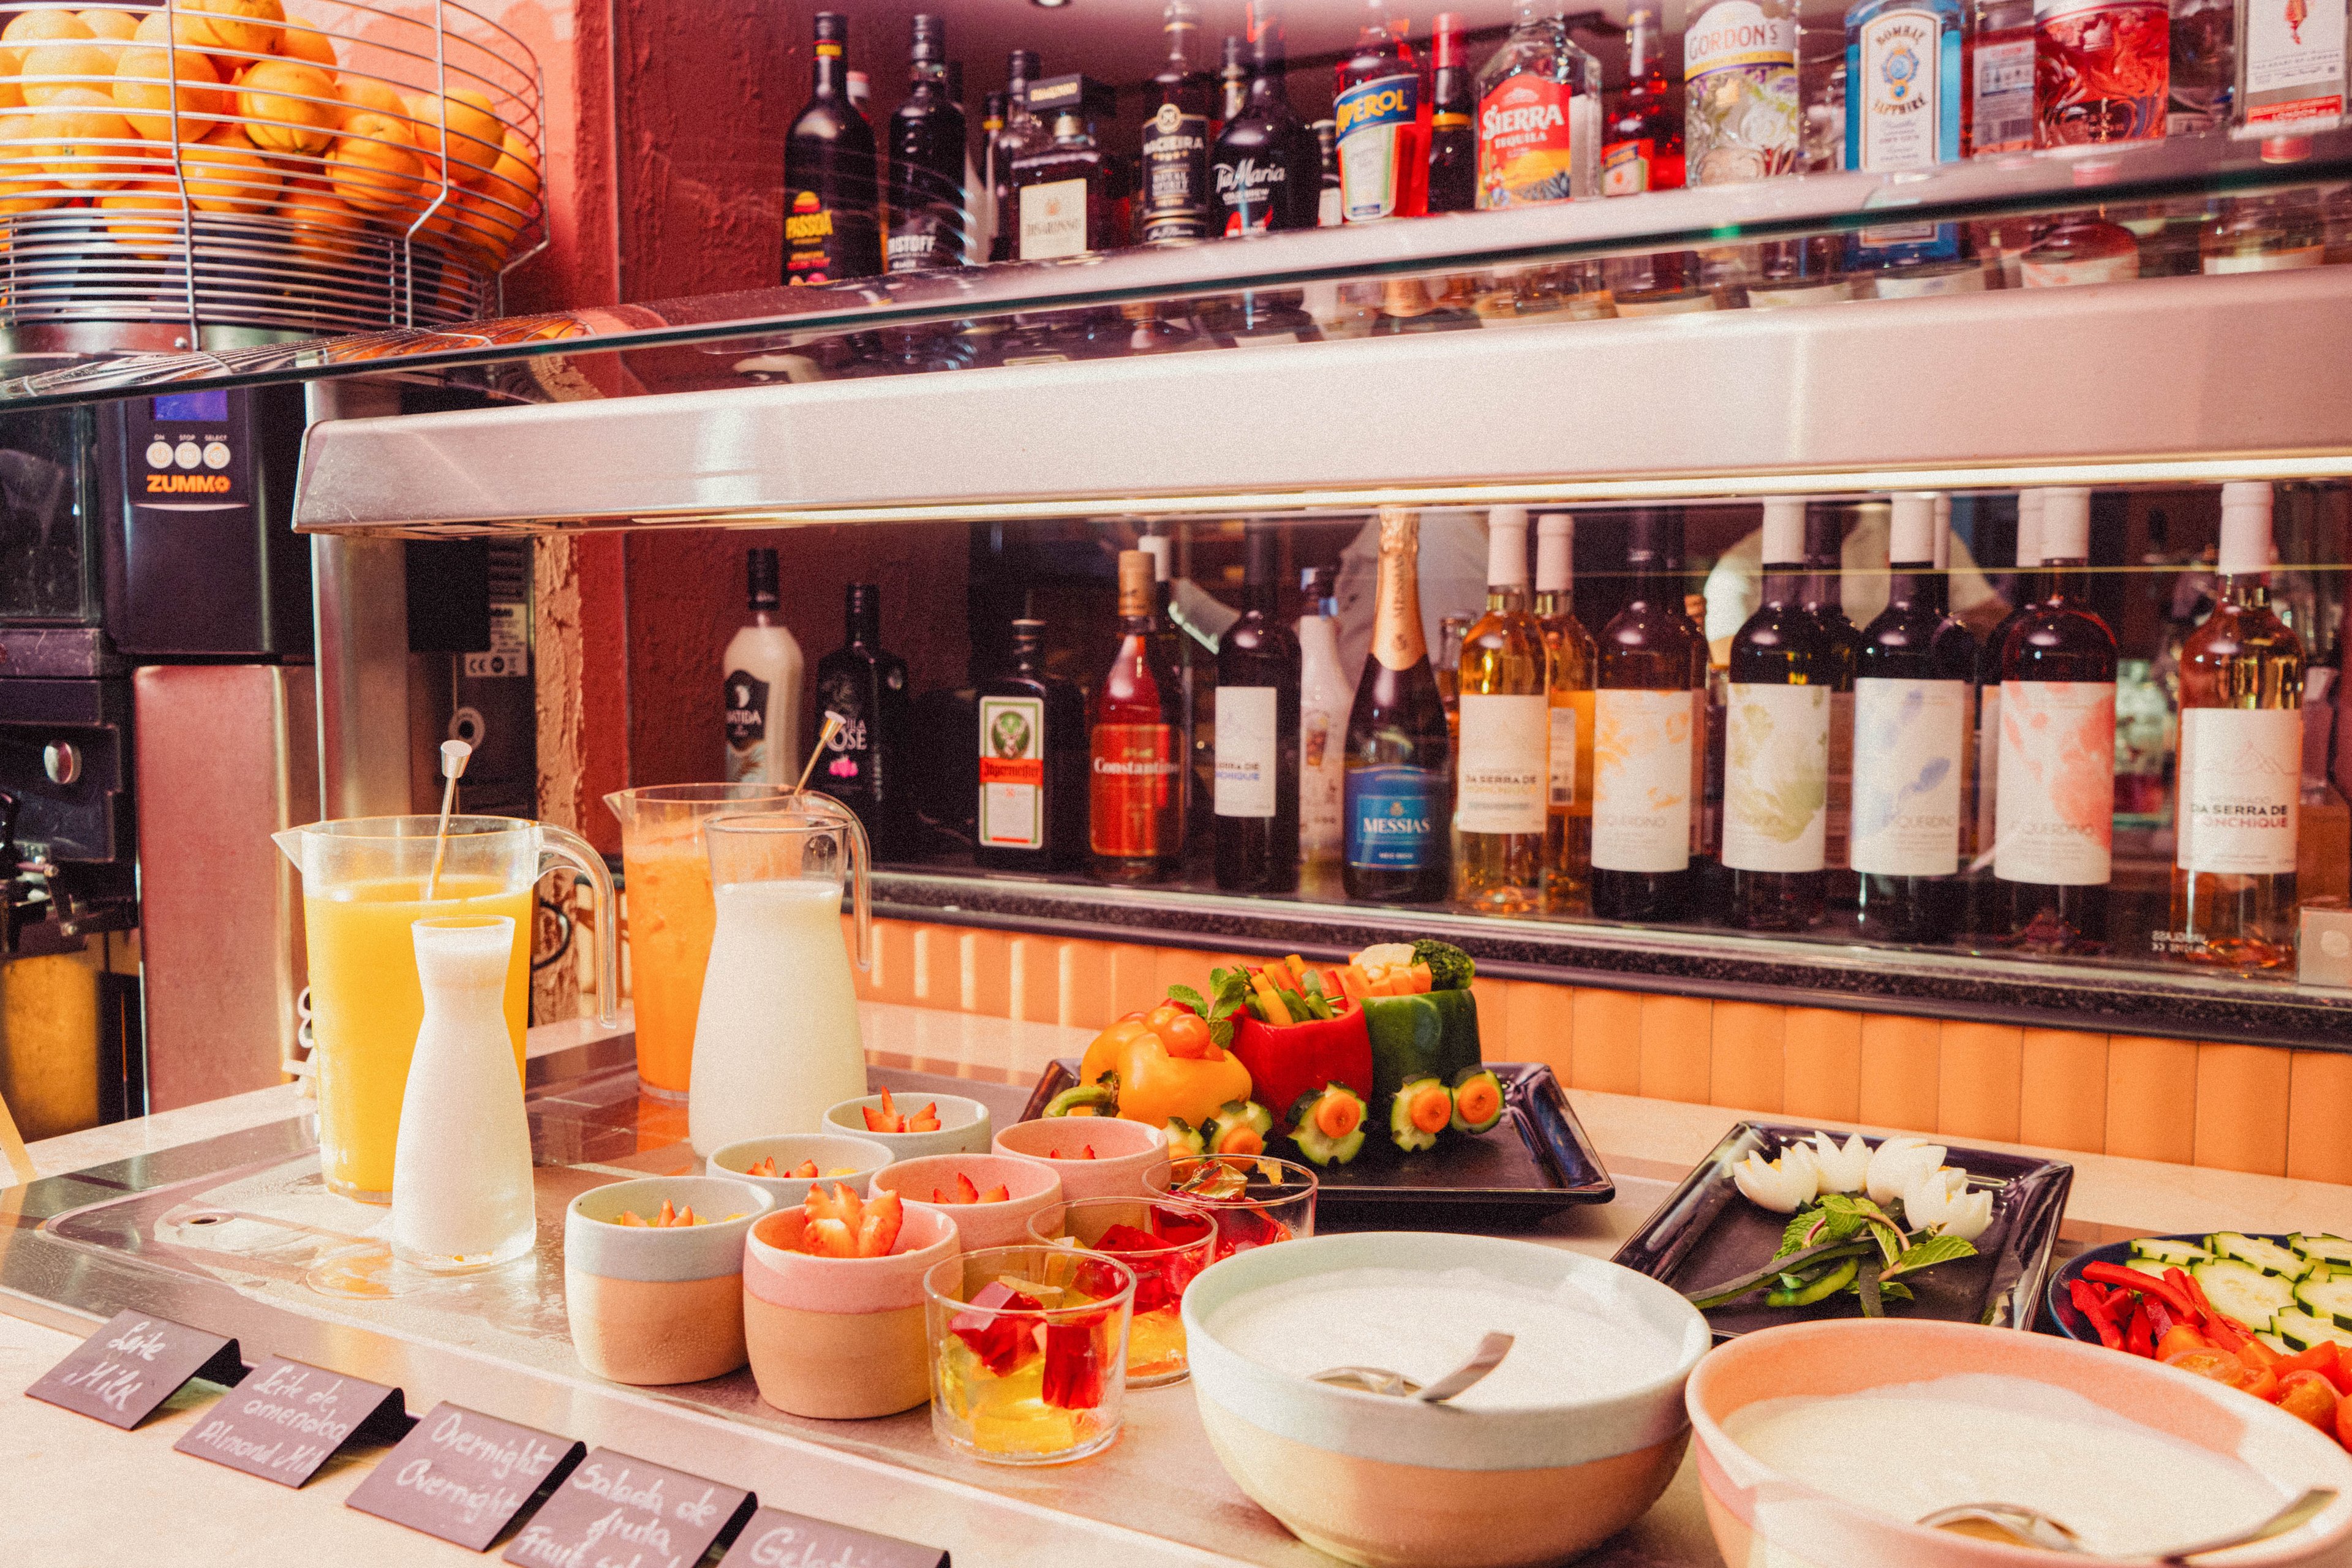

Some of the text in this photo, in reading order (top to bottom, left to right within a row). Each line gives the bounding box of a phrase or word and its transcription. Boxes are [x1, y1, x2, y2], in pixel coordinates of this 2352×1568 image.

[1876, 25, 1925, 49] BOMBAY
[1336, 89, 1408, 137] APEROL
[1482, 104, 1564, 141] SIERRA
[1494, 131, 1548, 149] TEQUILA
[146, 475, 231, 492] ZUMMO
[827, 727, 868, 752] OSE
[1522, 775, 1536, 785] DE
[2203, 816, 2288, 828] ONCHIQUE
[2212, 804, 2267, 816] SERRA
[2271, 805, 2288, 816] DE
[1364, 818, 1431, 834] MESSIAS
[307, 1379, 337, 1412] de
[432, 1412, 554, 1480] Overnight
[396, 1458, 522, 1524] Overnight
[572, 1463, 718, 1527] Salada de
[586, 1507, 670, 1556] fruta
